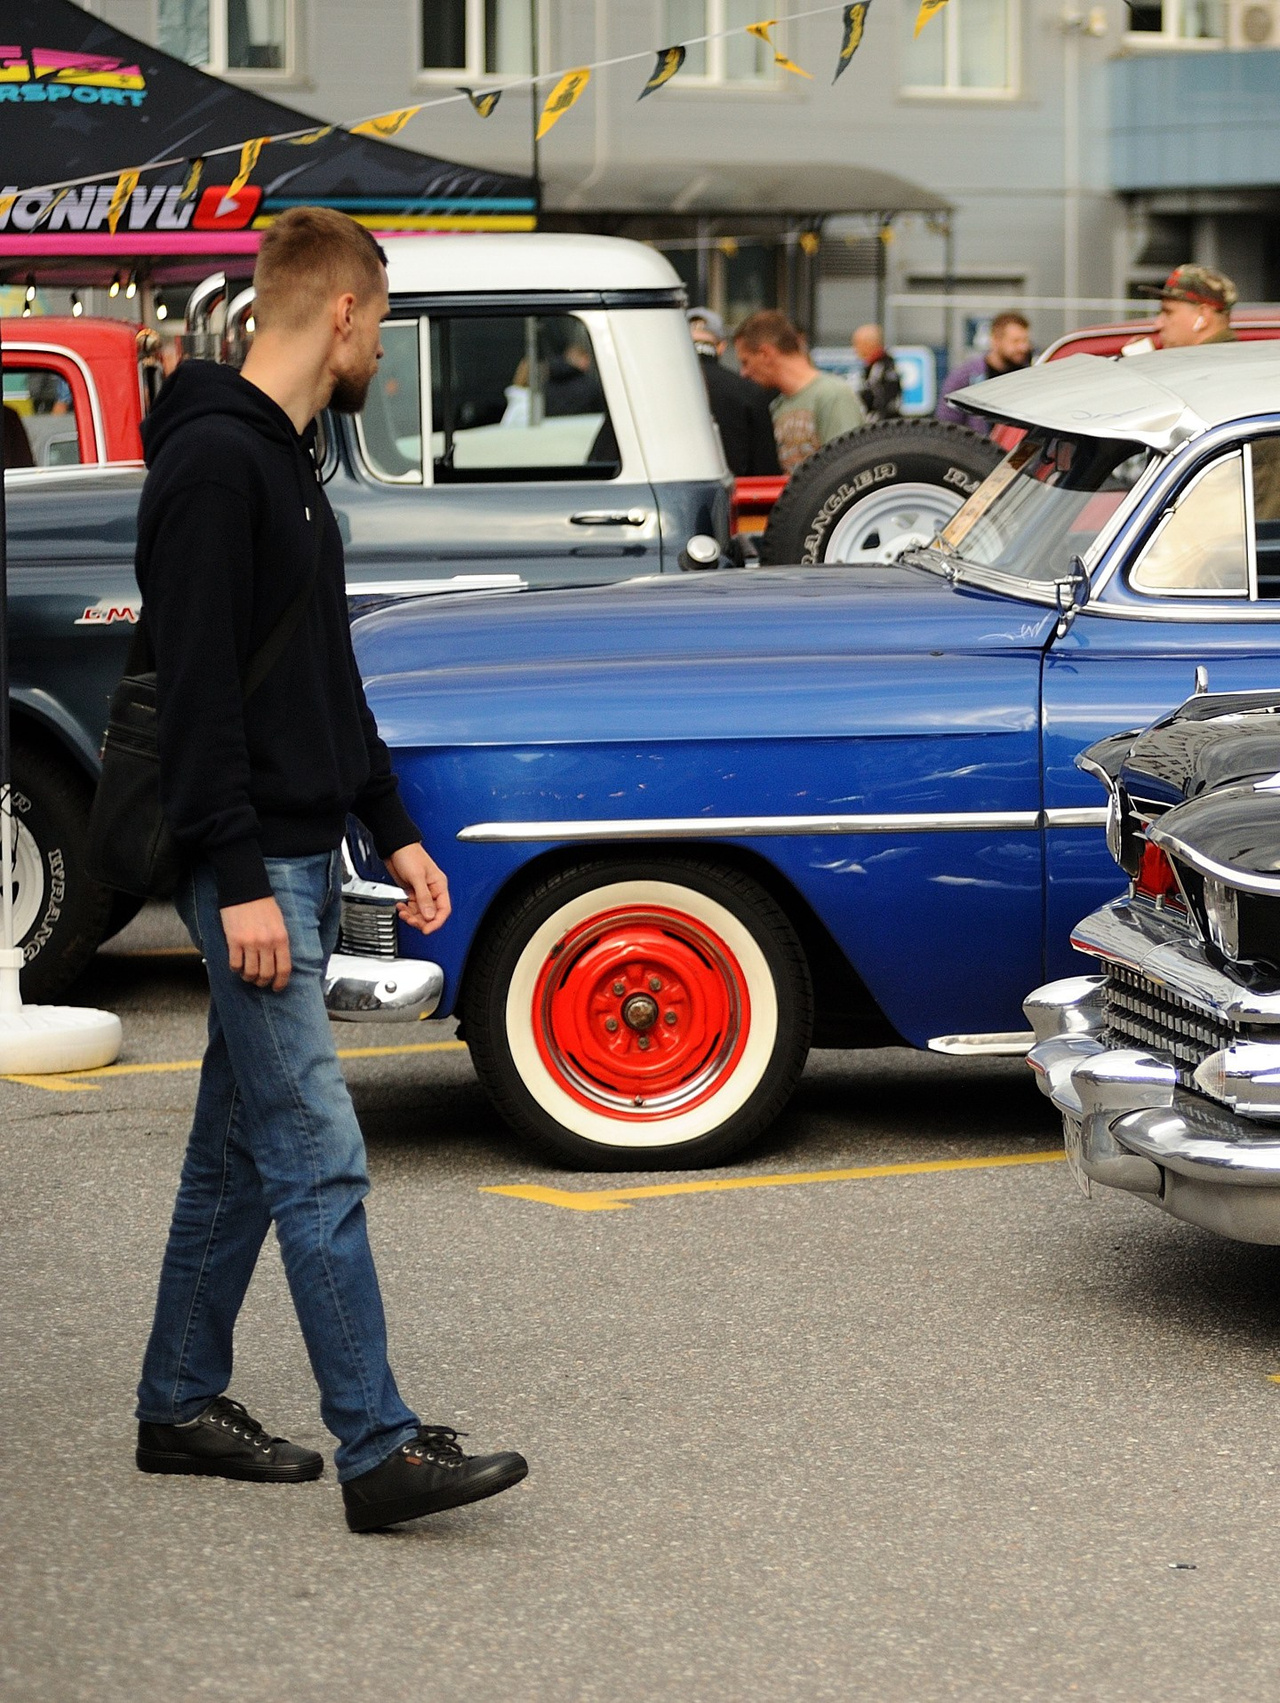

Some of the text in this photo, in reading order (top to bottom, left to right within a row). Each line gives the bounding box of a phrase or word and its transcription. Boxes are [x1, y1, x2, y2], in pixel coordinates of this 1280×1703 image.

[0, 83, 147, 106] RSPORT
[801, 463, 897, 565] RANGLER
[83, 606, 138, 624] GM
[24, 848, 65, 961] WRANG
